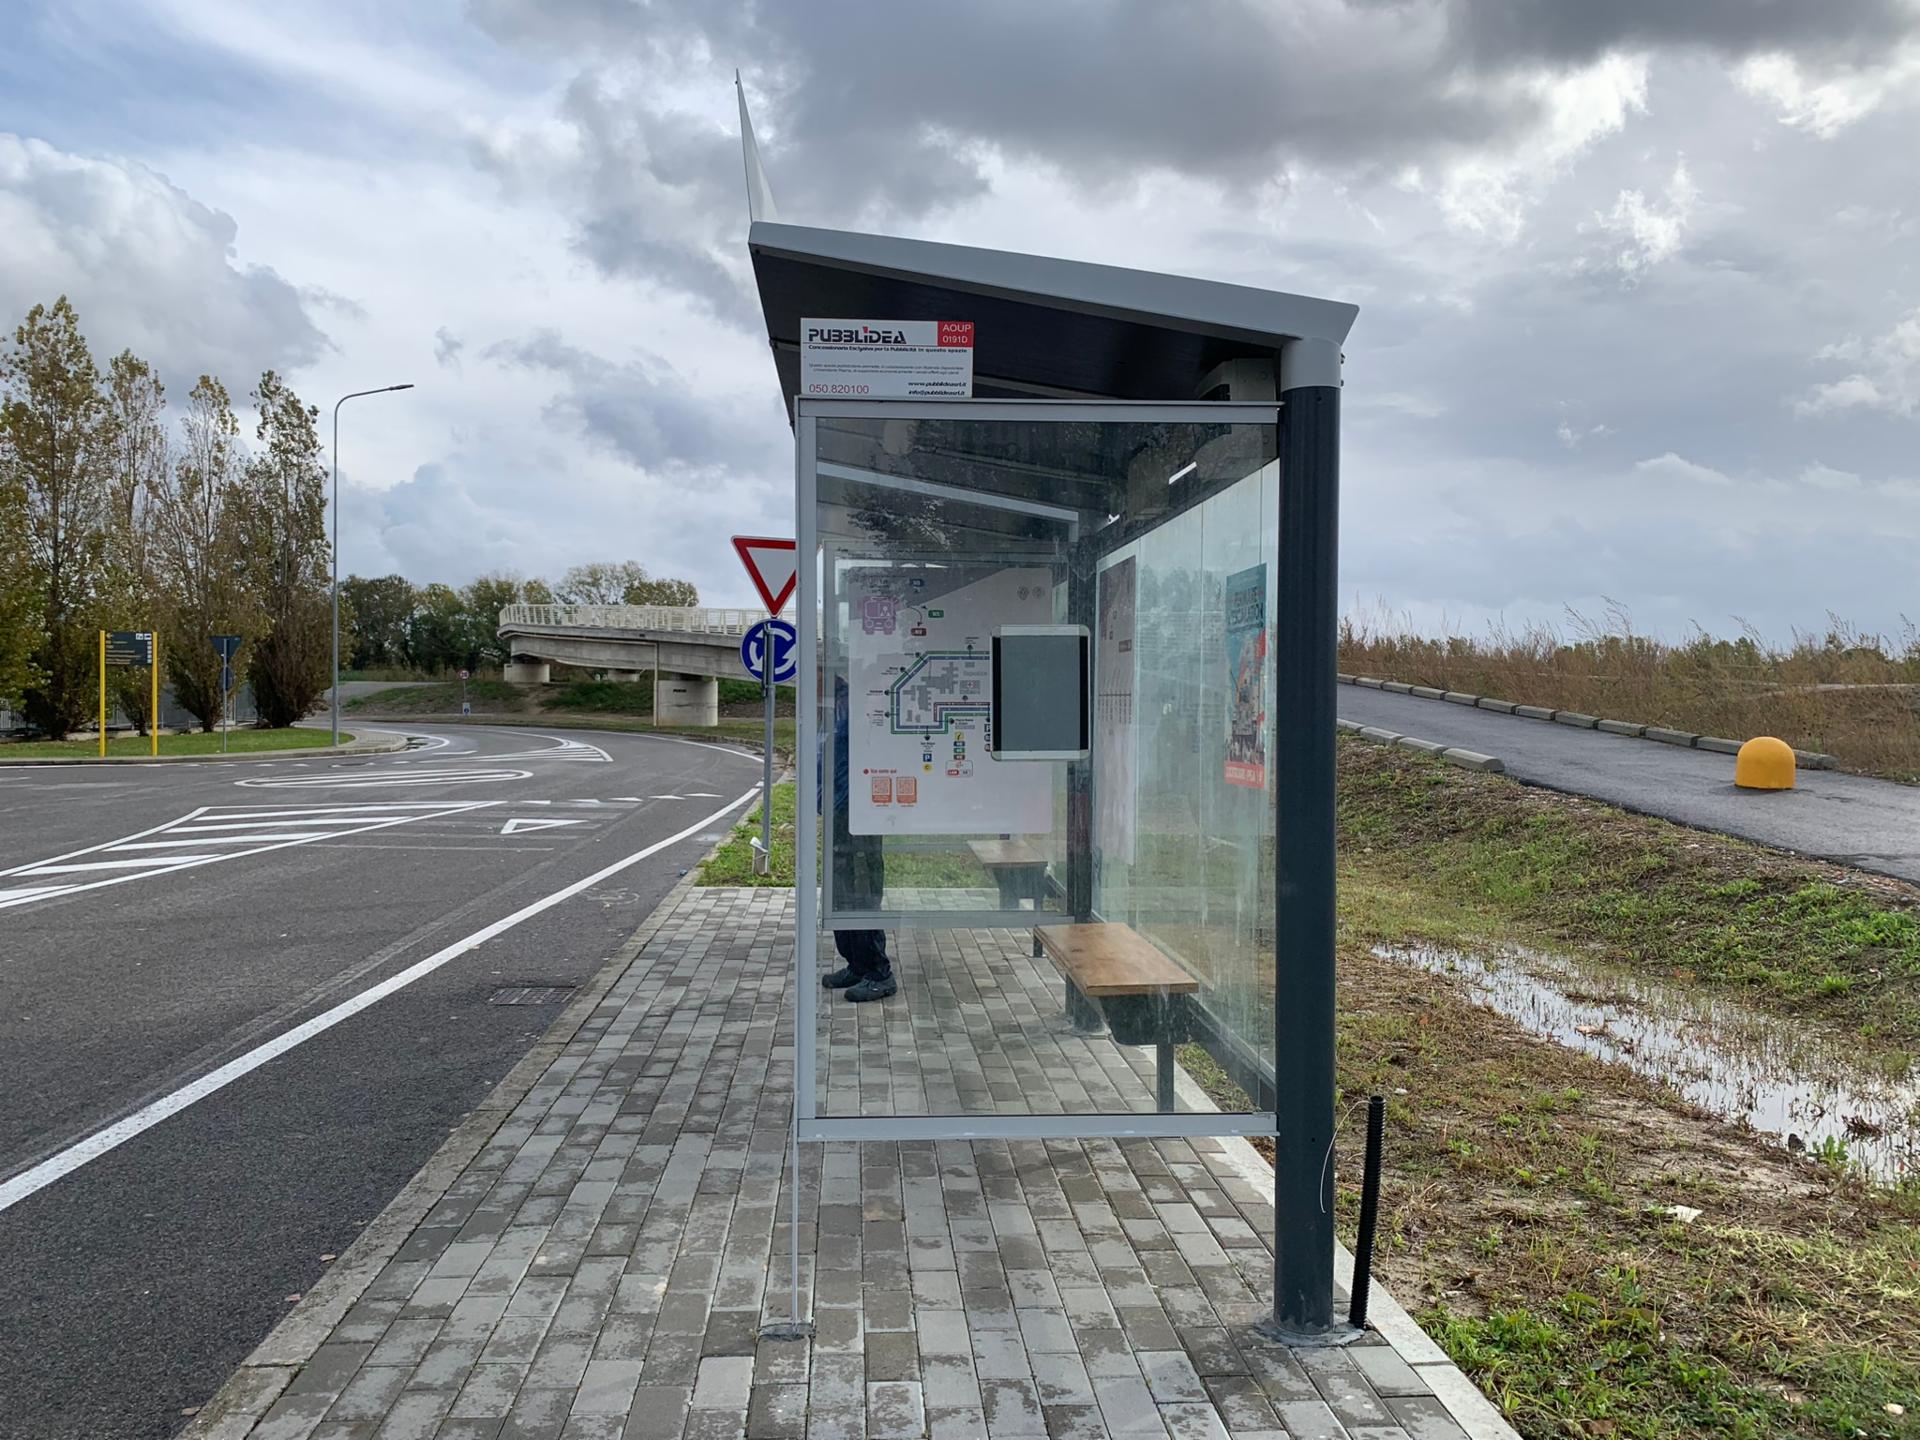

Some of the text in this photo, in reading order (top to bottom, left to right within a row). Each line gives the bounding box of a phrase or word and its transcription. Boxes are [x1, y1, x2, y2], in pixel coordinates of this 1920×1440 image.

[942, 323, 972, 333] AOUP
[808, 326, 907, 345] PUBBLIDEA
[942, 335, 968, 344] 0191D
[808, 383, 870, 394] 050.820100
